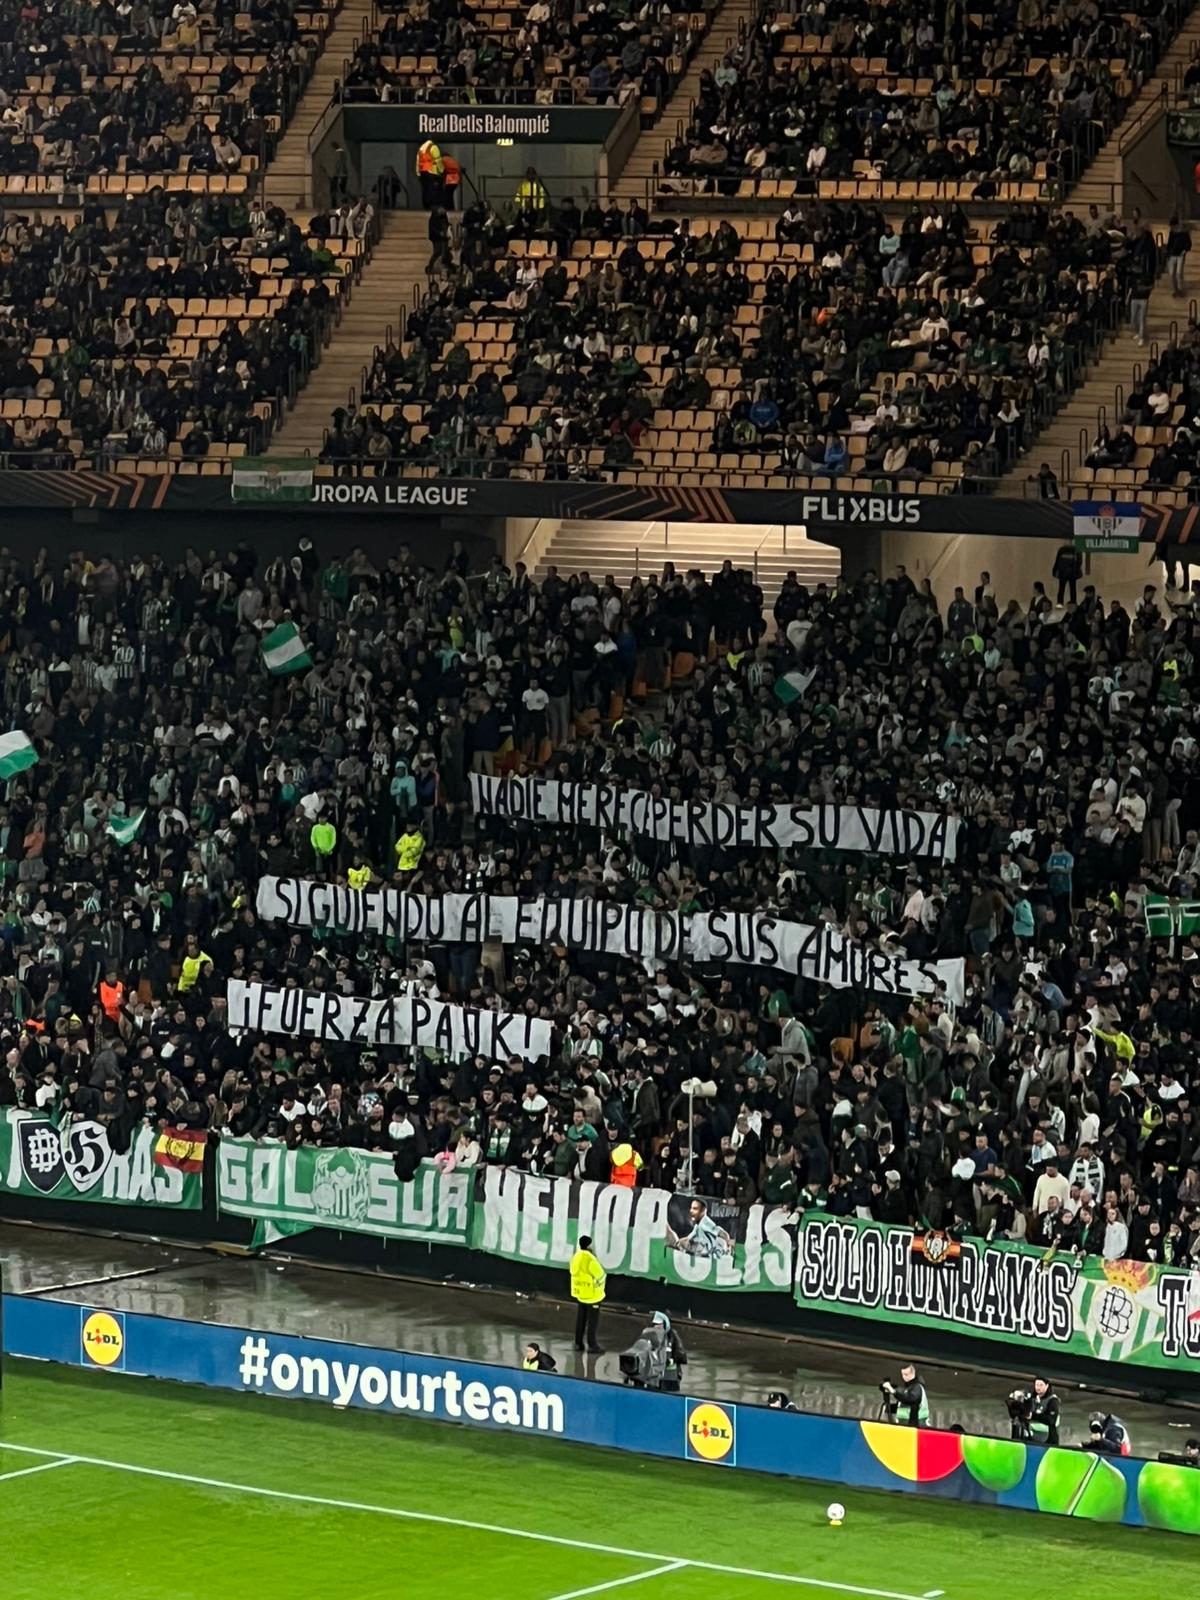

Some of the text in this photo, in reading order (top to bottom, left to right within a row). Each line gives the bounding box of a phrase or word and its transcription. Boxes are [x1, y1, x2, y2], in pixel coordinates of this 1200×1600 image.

[419, 113, 549, 136] Real Betis Balompié
[310, 484, 379, 504] UROPA
[385, 485, 469, 505] LEAGUE
[477, 774, 548, 821] NADIE
[651, 797, 779, 848] PERDER
[790, 803, 840, 849] SU
[857, 806, 946, 858] VIDA
[274, 876, 444, 939] SIGUIENDO
[460, 893, 502, 942] AL
[515, 897, 644, 955] EQUIPO
[655, 909, 694, 963] DE
[708, 909, 779, 967] SUS
[219, 1142, 470, 1231] GOL SUR
[801, 1221, 884, 1308] SOLO
[239, 1336, 565, 1433] #onyourteam
